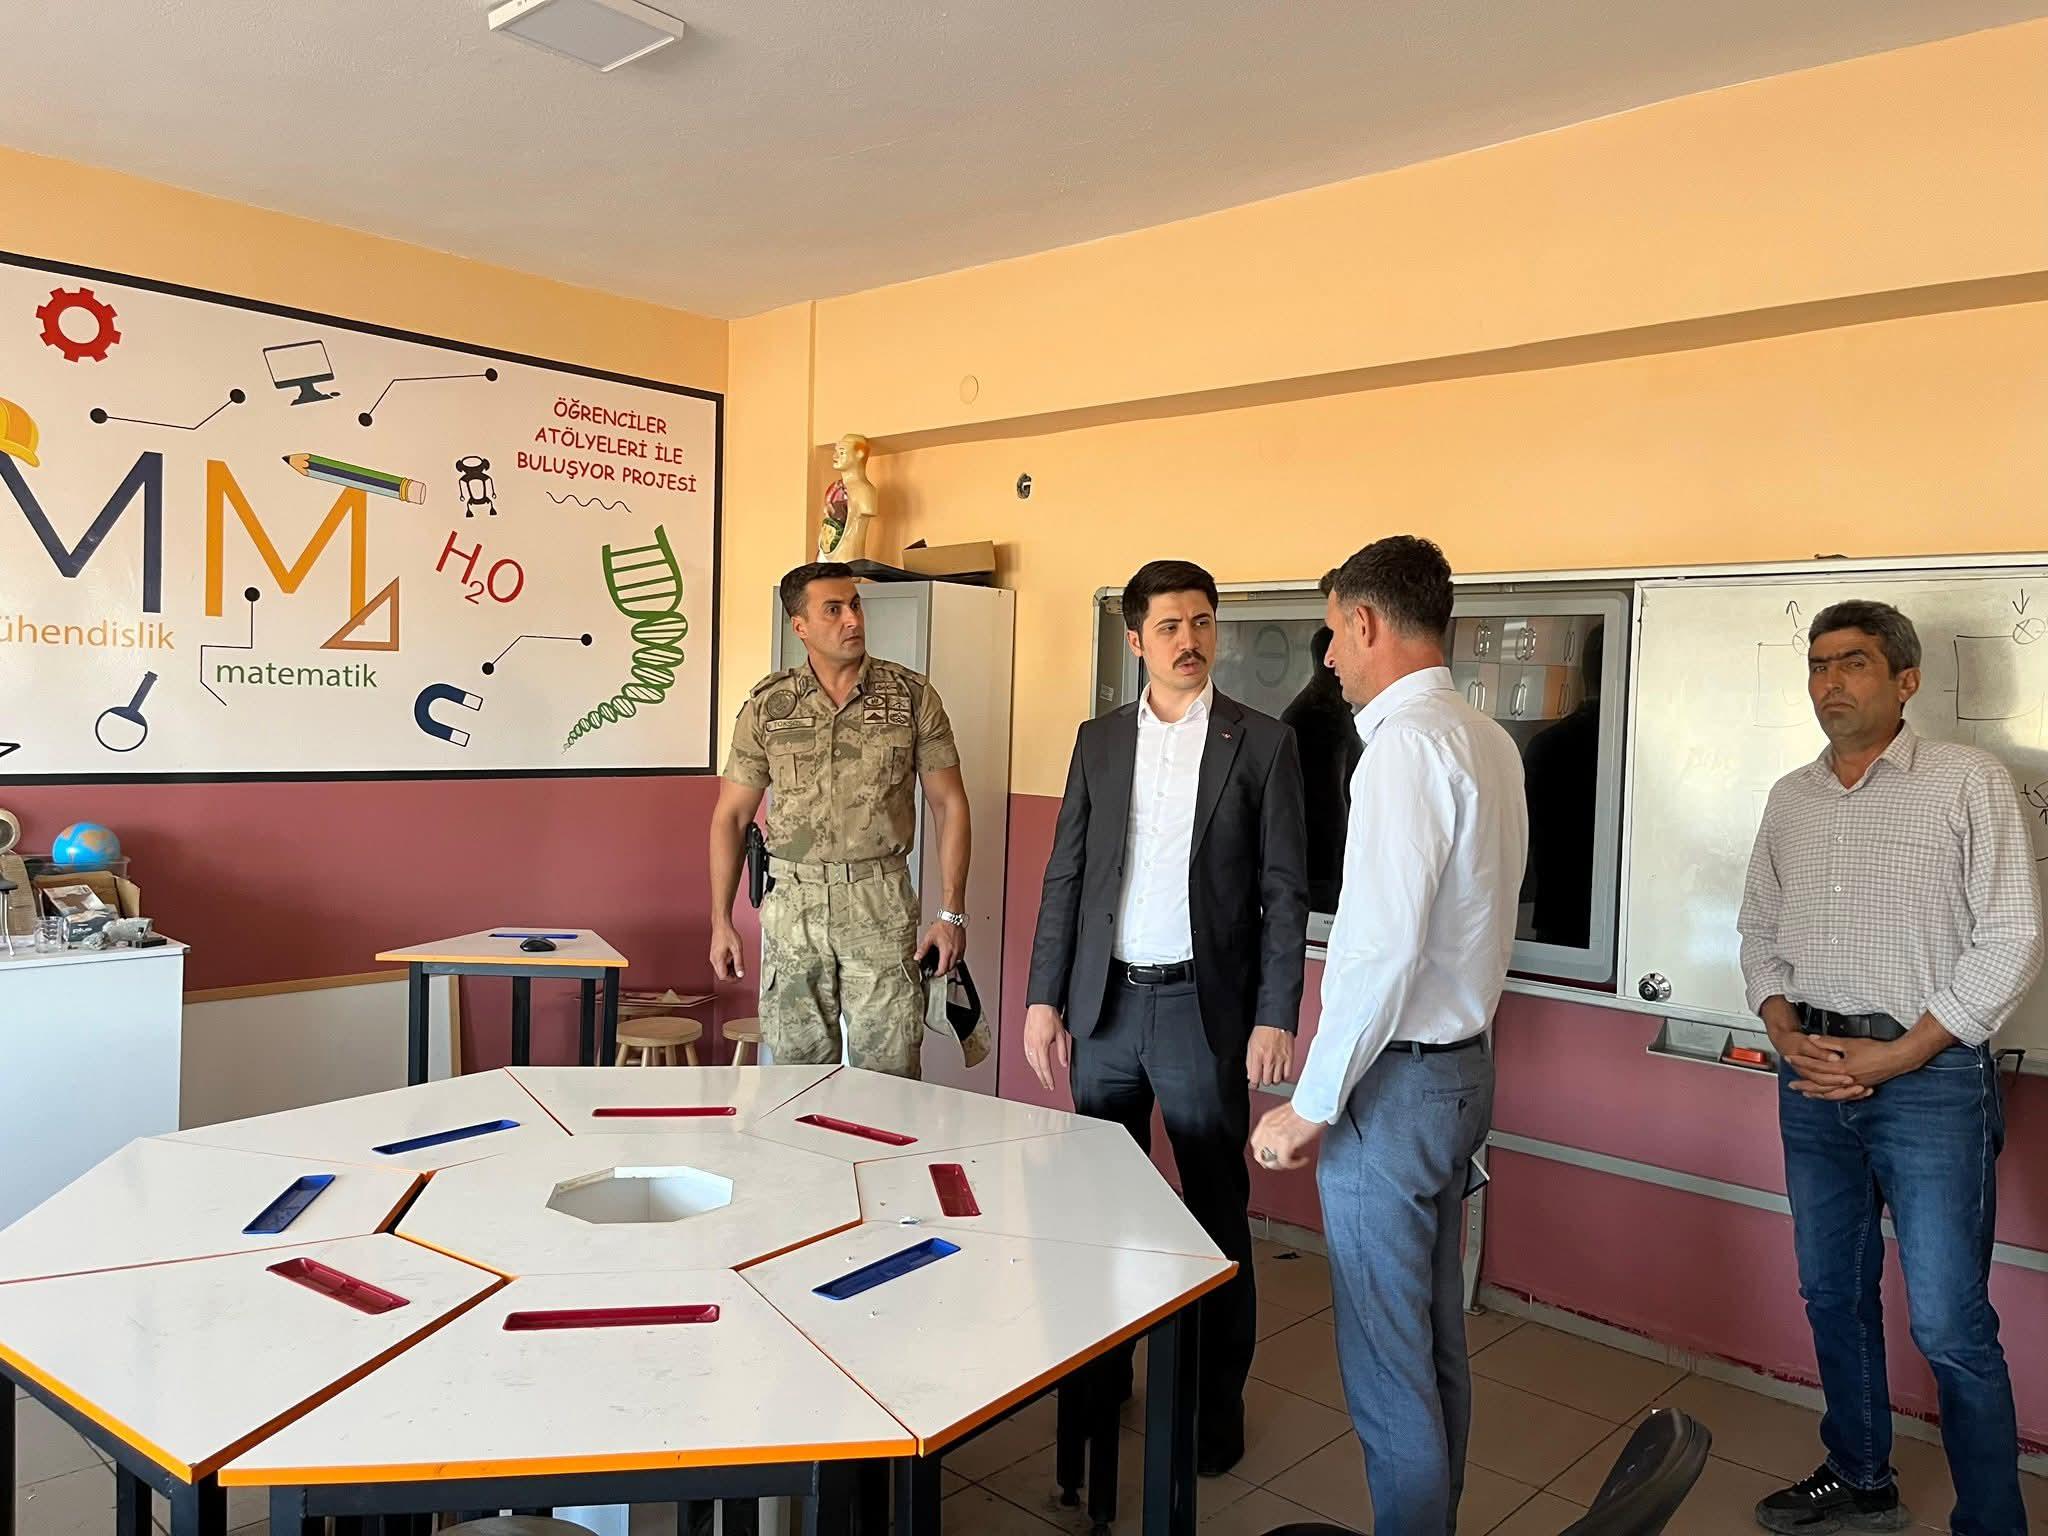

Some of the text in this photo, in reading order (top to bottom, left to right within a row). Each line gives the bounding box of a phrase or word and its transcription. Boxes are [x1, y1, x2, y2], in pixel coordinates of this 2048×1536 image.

[553, 397, 667, 435] ÖĞRENCİLER
[535, 427, 683, 465] ATÖLYELERİ İLE
[517, 451, 697, 493] BULUŞYOR PROJESİ
[435, 530, 525, 605] H2O
[216, 662, 378, 688] matematik
